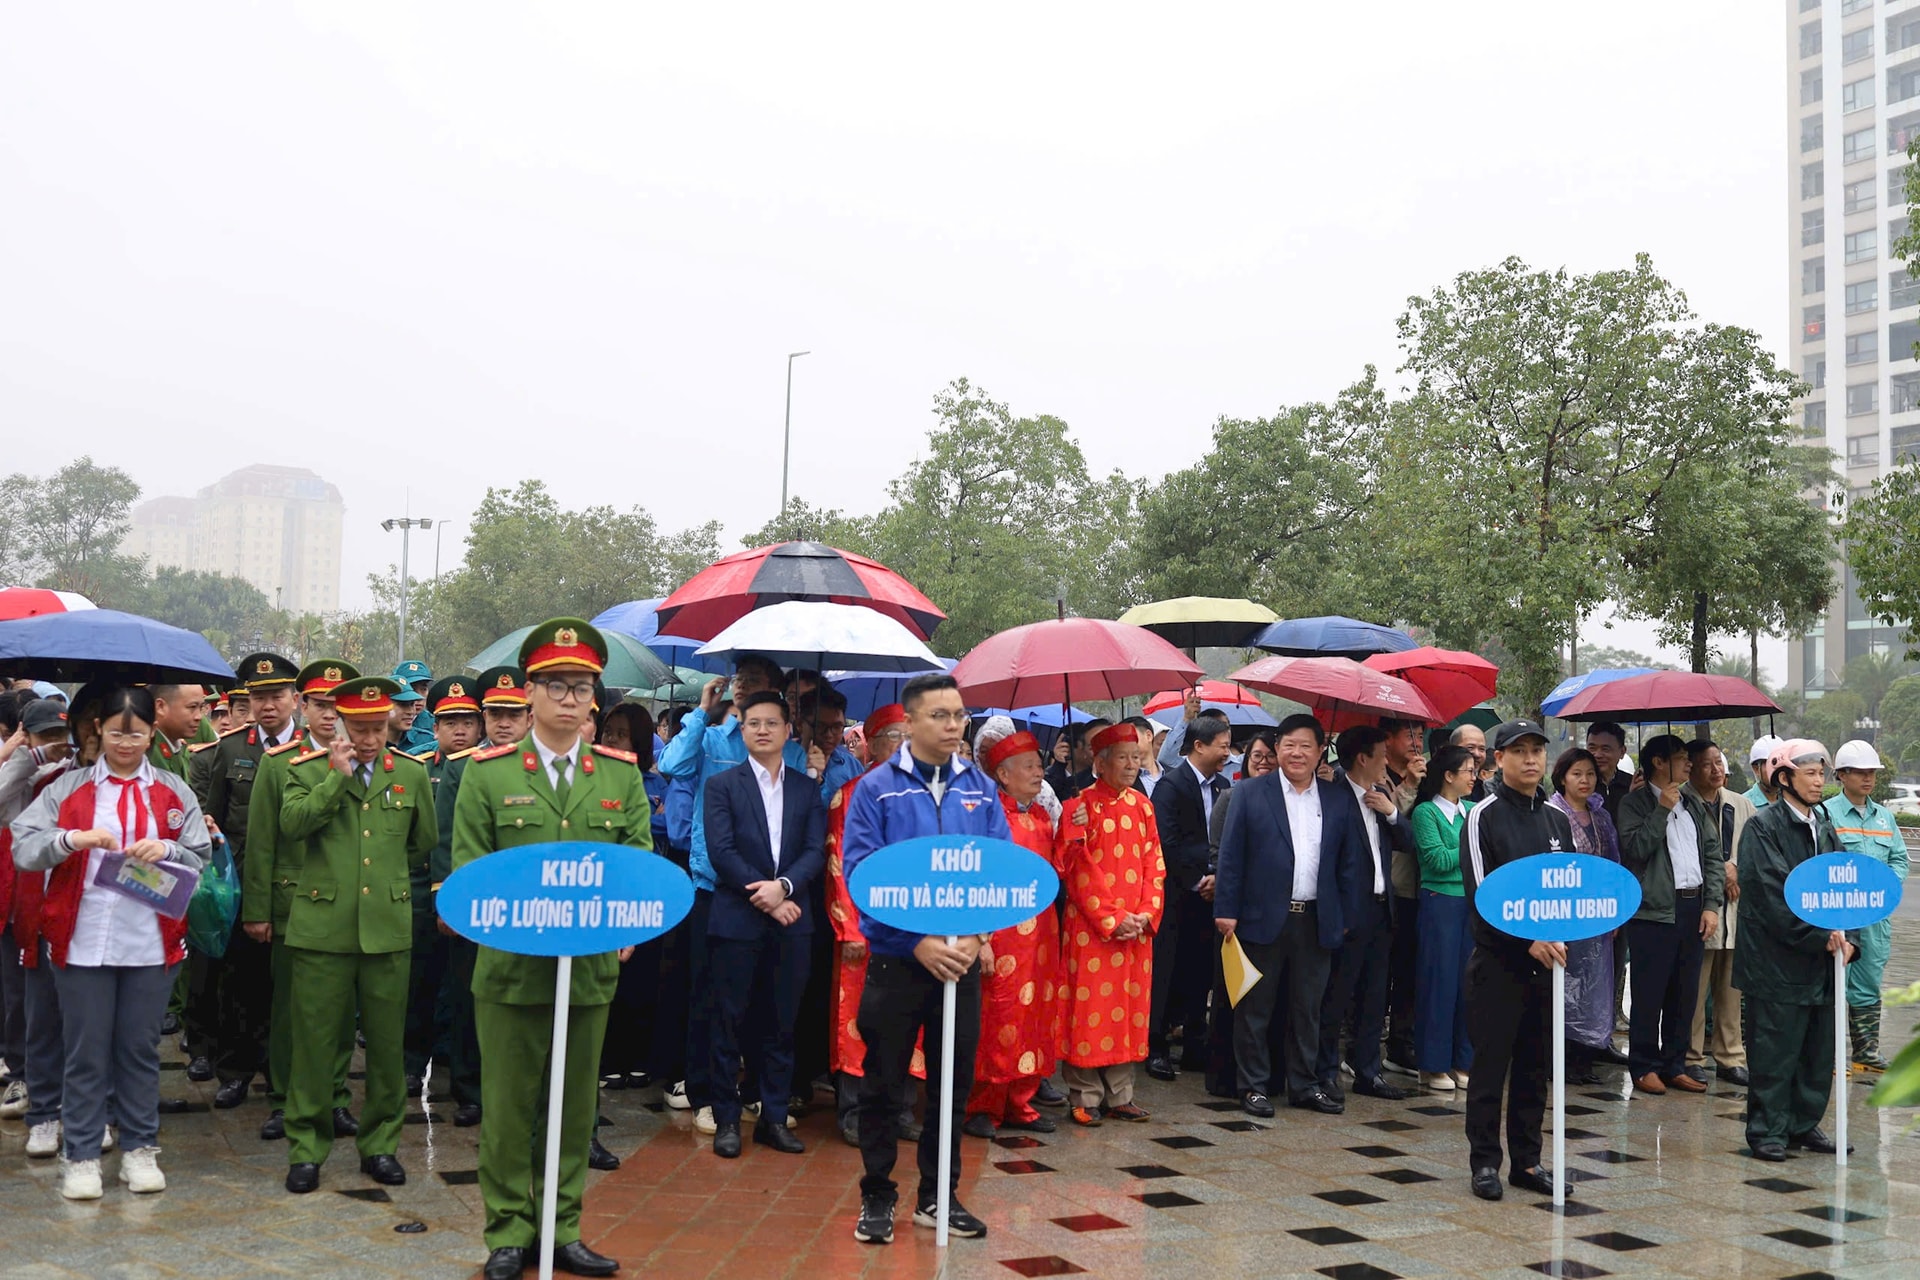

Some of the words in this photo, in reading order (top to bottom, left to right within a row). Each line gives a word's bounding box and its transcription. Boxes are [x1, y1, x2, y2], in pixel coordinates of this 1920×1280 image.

[541, 852, 603, 887] KHỐI
[931, 841, 982, 872] KHỐI
[1541, 861, 1582, 889] KHỐI
[1828, 860, 1858, 884] KHỐI
[869, 886, 909, 910] MTTQ
[912, 882, 932, 908] VÀ
[935, 882, 964, 908] CÁC
[968, 883, 1007, 908] ĐOÀN
[1011, 879, 1038, 908] THỂ
[1801, 892, 1820, 913] ĐỊA
[1821, 888, 1844, 909] BÀN
[1846, 888, 1868, 908] DÂN
[1869, 889, 1885, 908] CƯ
[470, 896, 508, 933] LỰC
[511, 897, 573, 933] LƯỢNG
[578, 895, 602, 927] VŨ
[607, 900, 664, 928] TRANG
[1502, 897, 1525, 921] CƠ
[1529, 899, 1572, 923] QUAN
[1576, 898, 1617, 919] UBND
